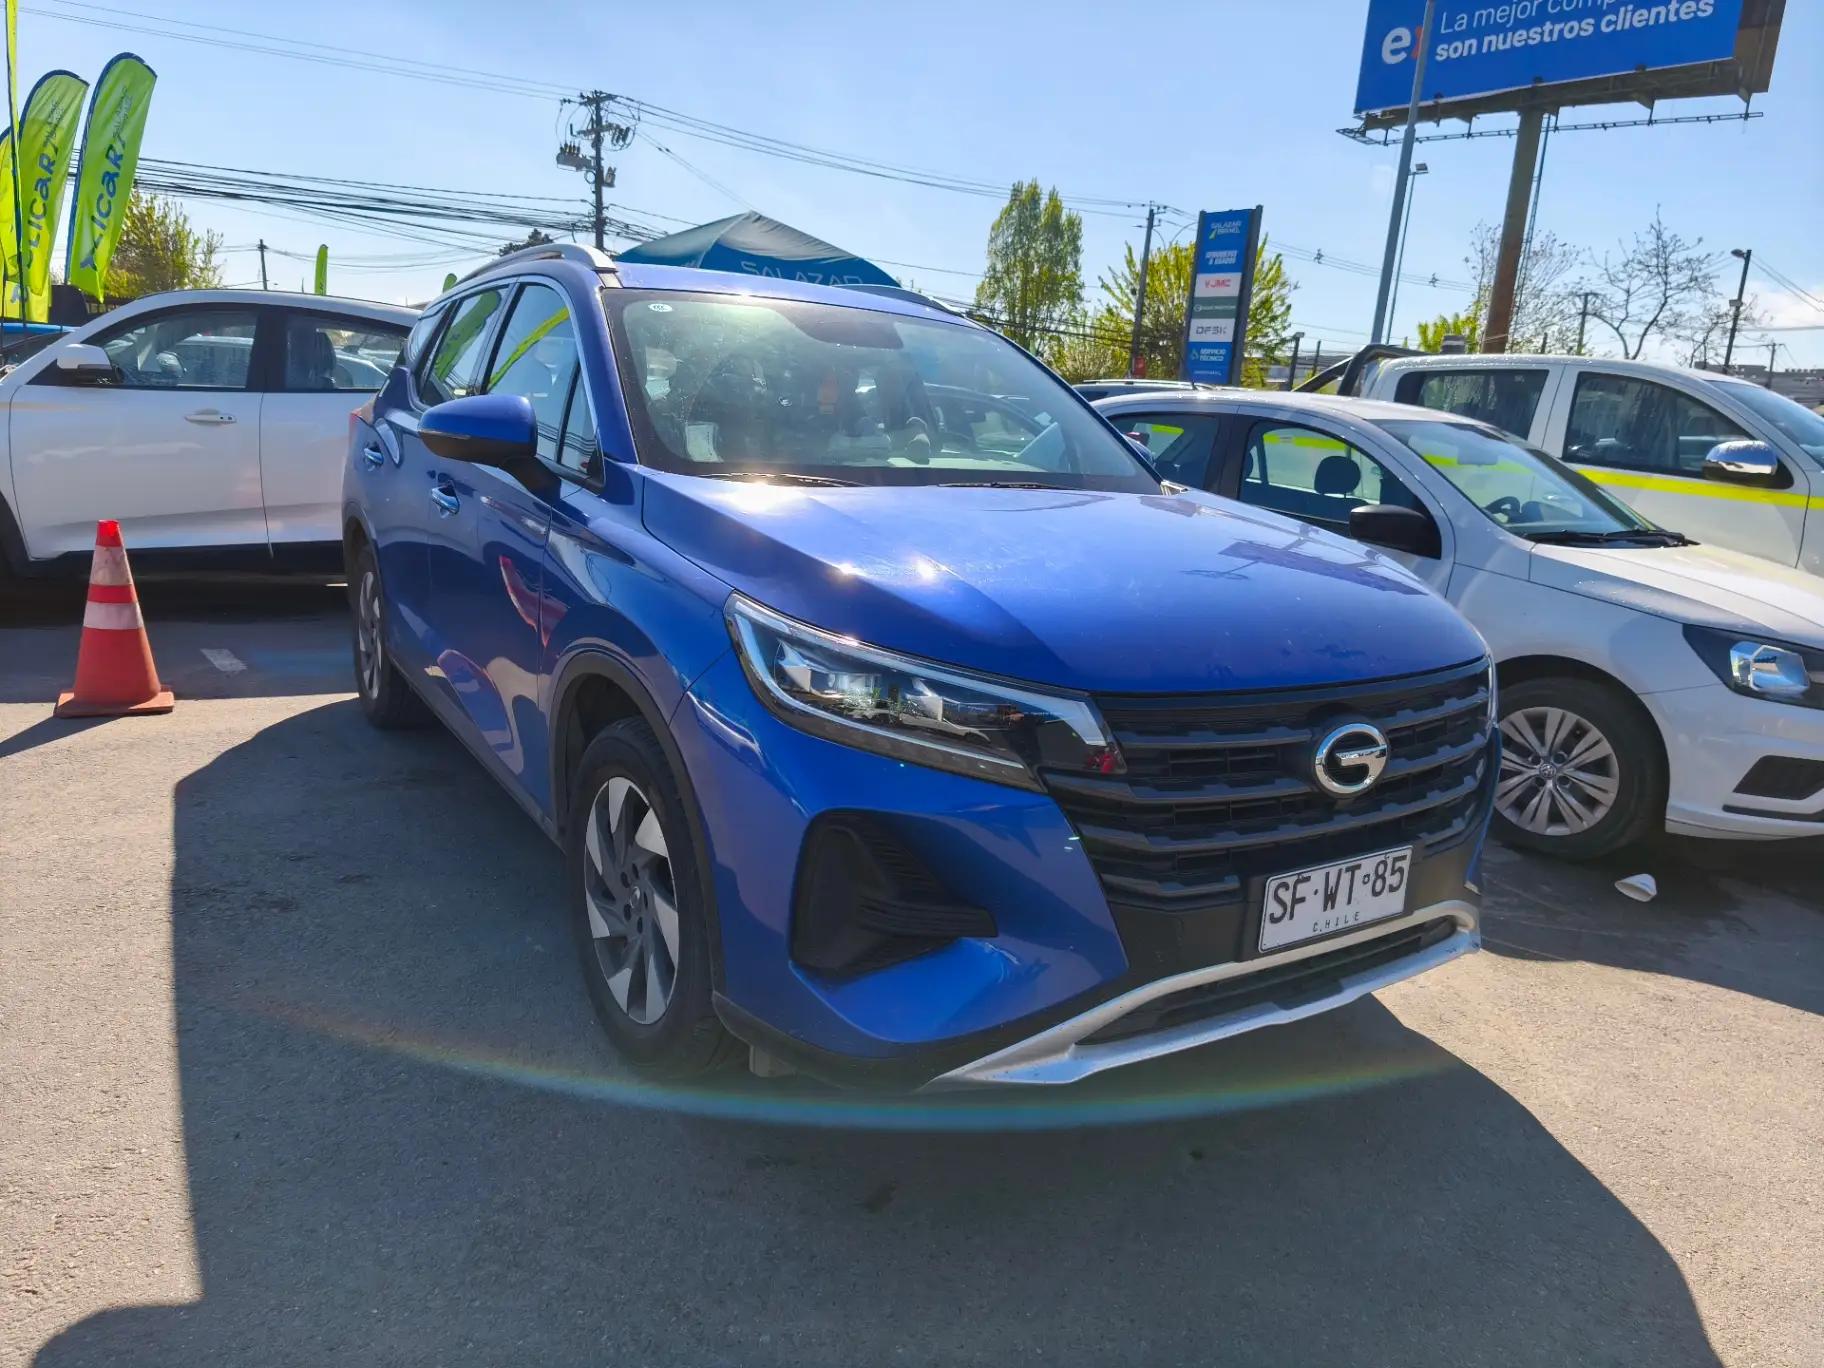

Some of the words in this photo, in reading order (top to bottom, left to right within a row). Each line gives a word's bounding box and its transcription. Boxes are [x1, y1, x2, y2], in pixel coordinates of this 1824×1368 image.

[1435, 38, 1477, 61] son
[1481, 18, 1595, 53] nuestros
[1601, 0, 1714, 33] clientes
[1440, 11, 1468, 34] La
[1473, 0, 1541, 28] mejor
[1313, 912, 1360, 932] CHILE
